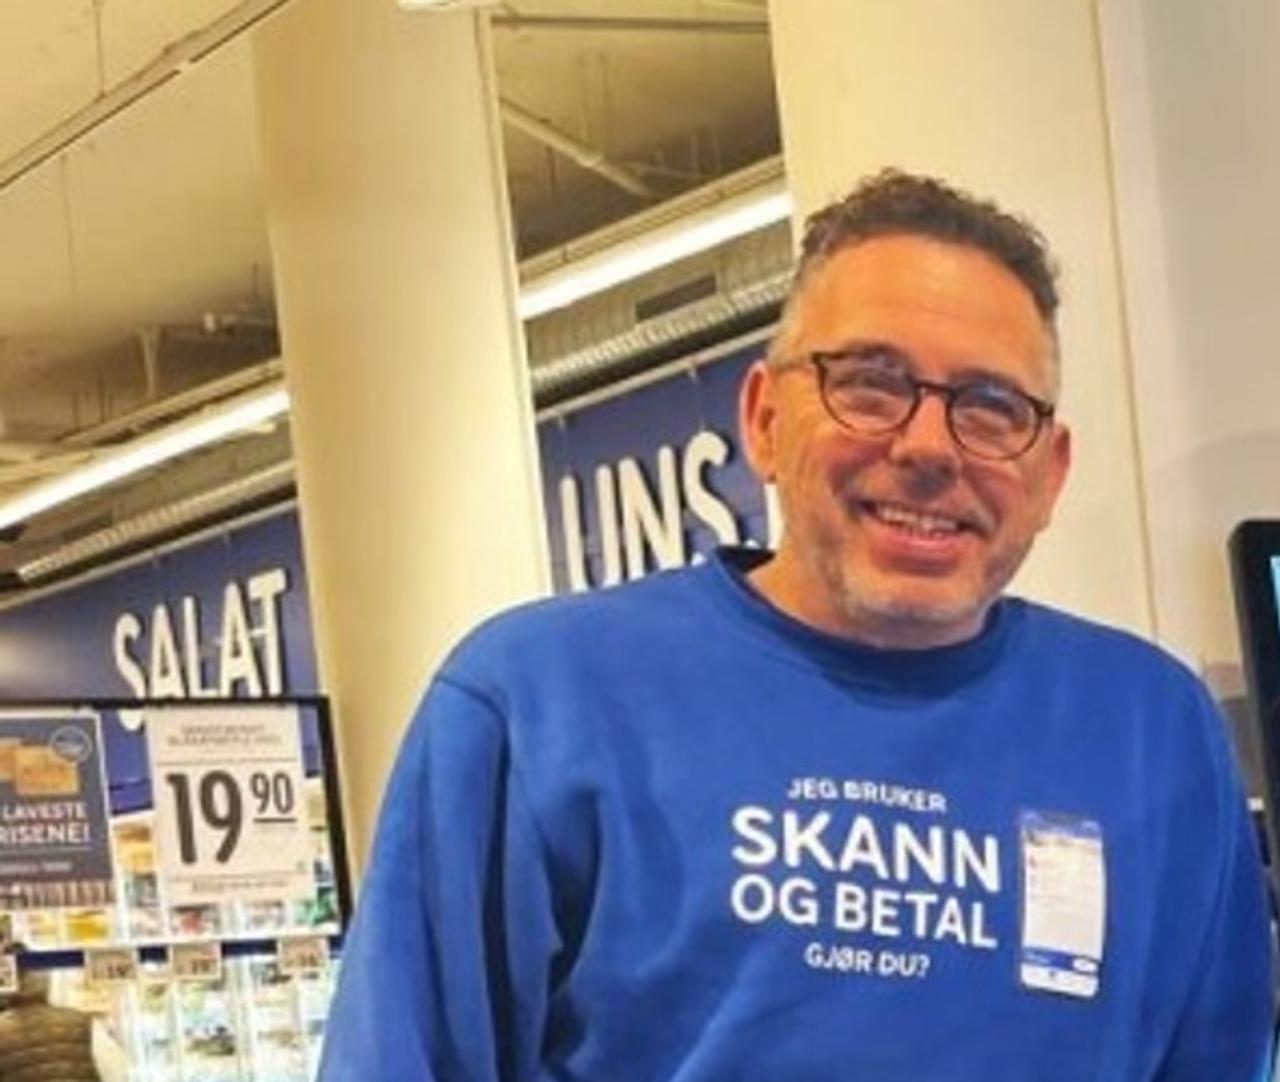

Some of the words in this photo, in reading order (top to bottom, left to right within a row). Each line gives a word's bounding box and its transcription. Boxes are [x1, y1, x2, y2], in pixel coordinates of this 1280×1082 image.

[114, 567, 287, 730] SALAT
[165, 770, 243, 865] 19
[250, 772, 294, 815] 90
[787, 777, 838, 800] JEG
[843, 781, 948, 813] BRUKER
[731, 804, 1001, 893] SKANN
[731, 874, 820, 925] OG
[835, 882, 998, 949] BETAL
[804, 942, 874, 973] GJØR
[878, 949, 931, 979] DU?
